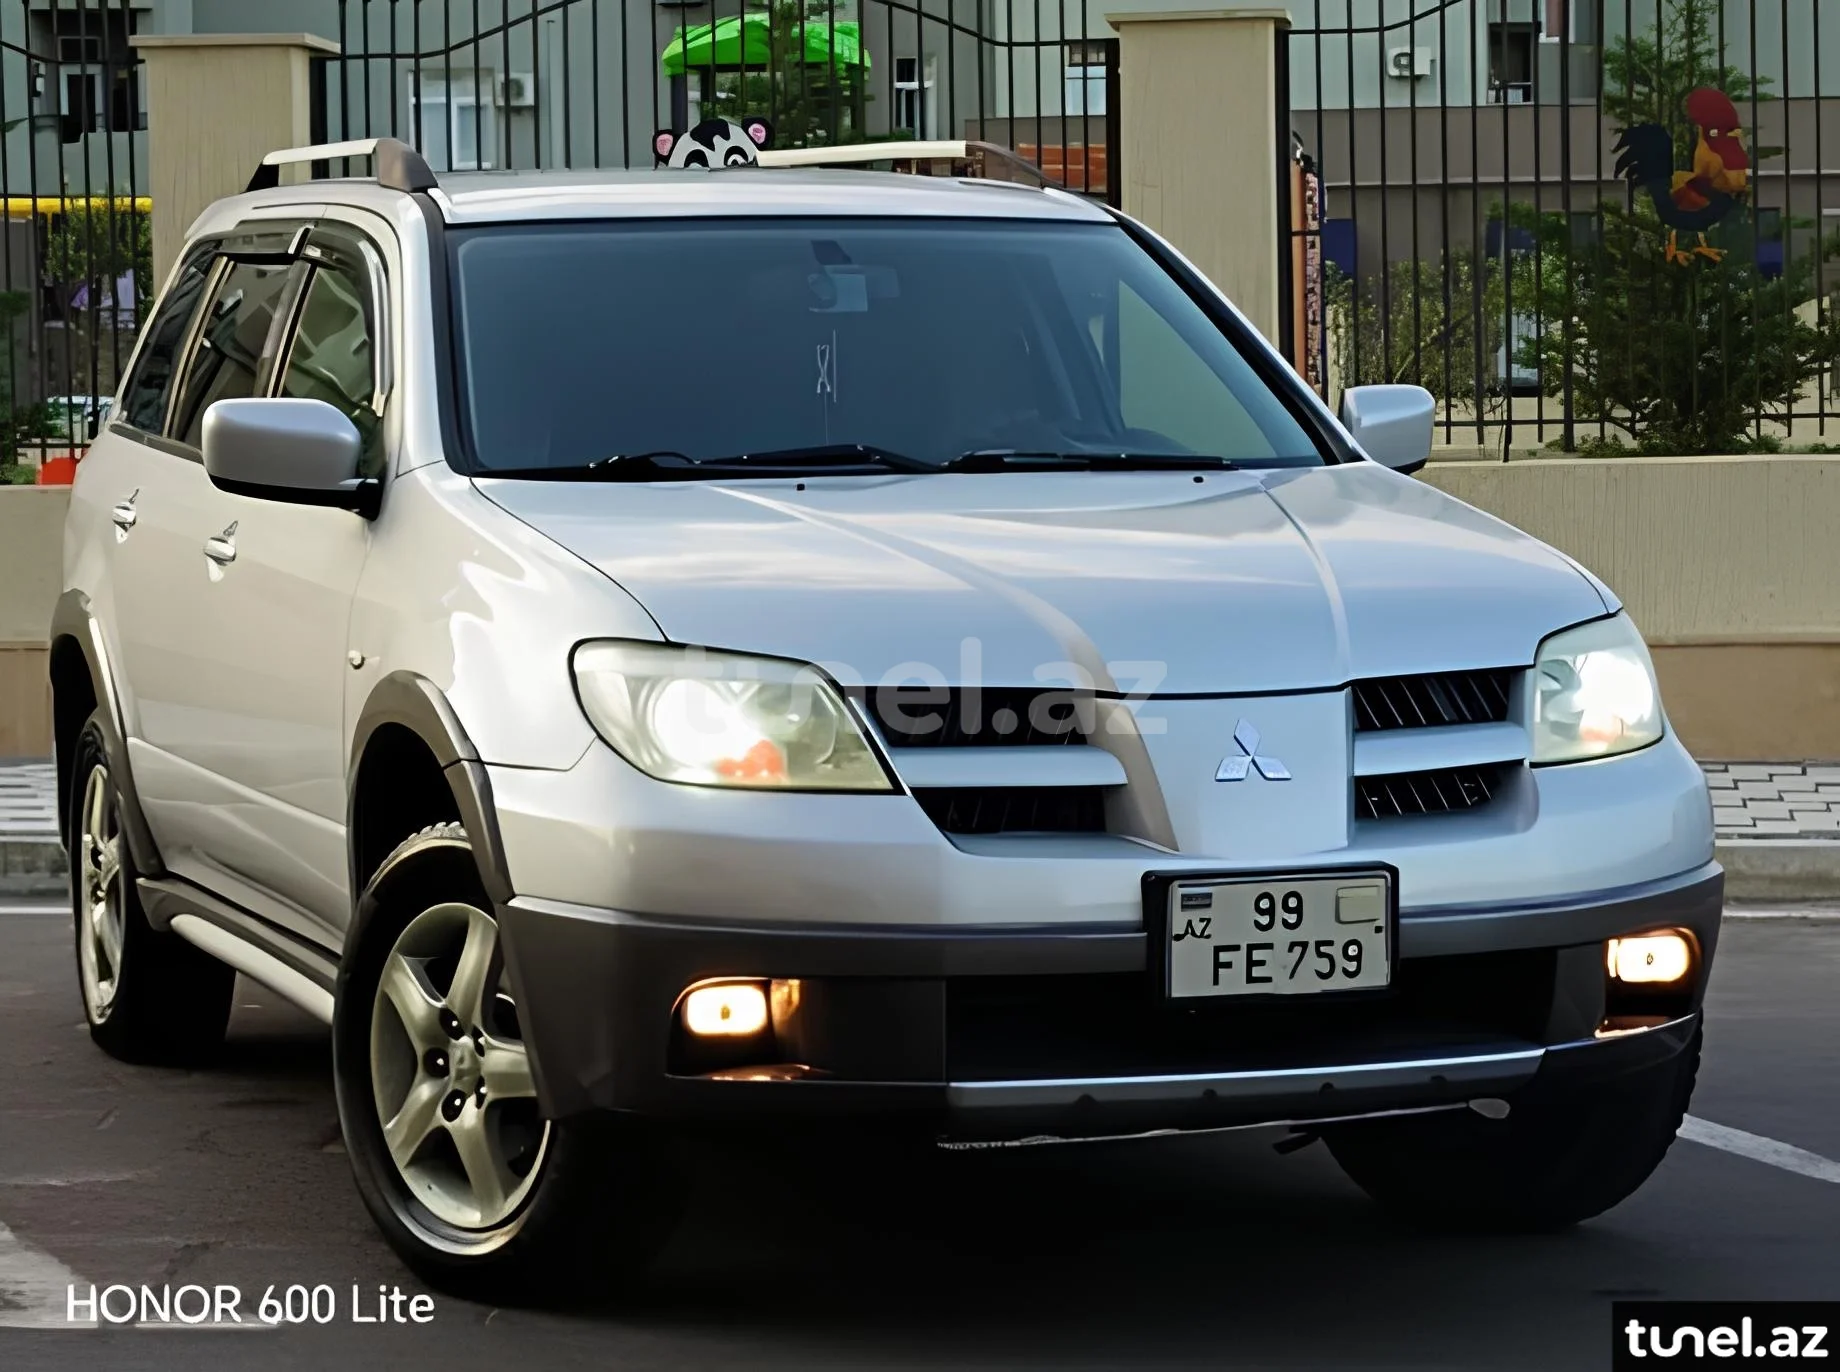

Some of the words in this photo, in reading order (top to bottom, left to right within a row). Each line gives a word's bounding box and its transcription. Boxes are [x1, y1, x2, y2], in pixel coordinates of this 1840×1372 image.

[1253, 890, 1304, 932] 99
[1212, 942, 1275, 986] FE
[1287, 938, 1363, 981] 759
